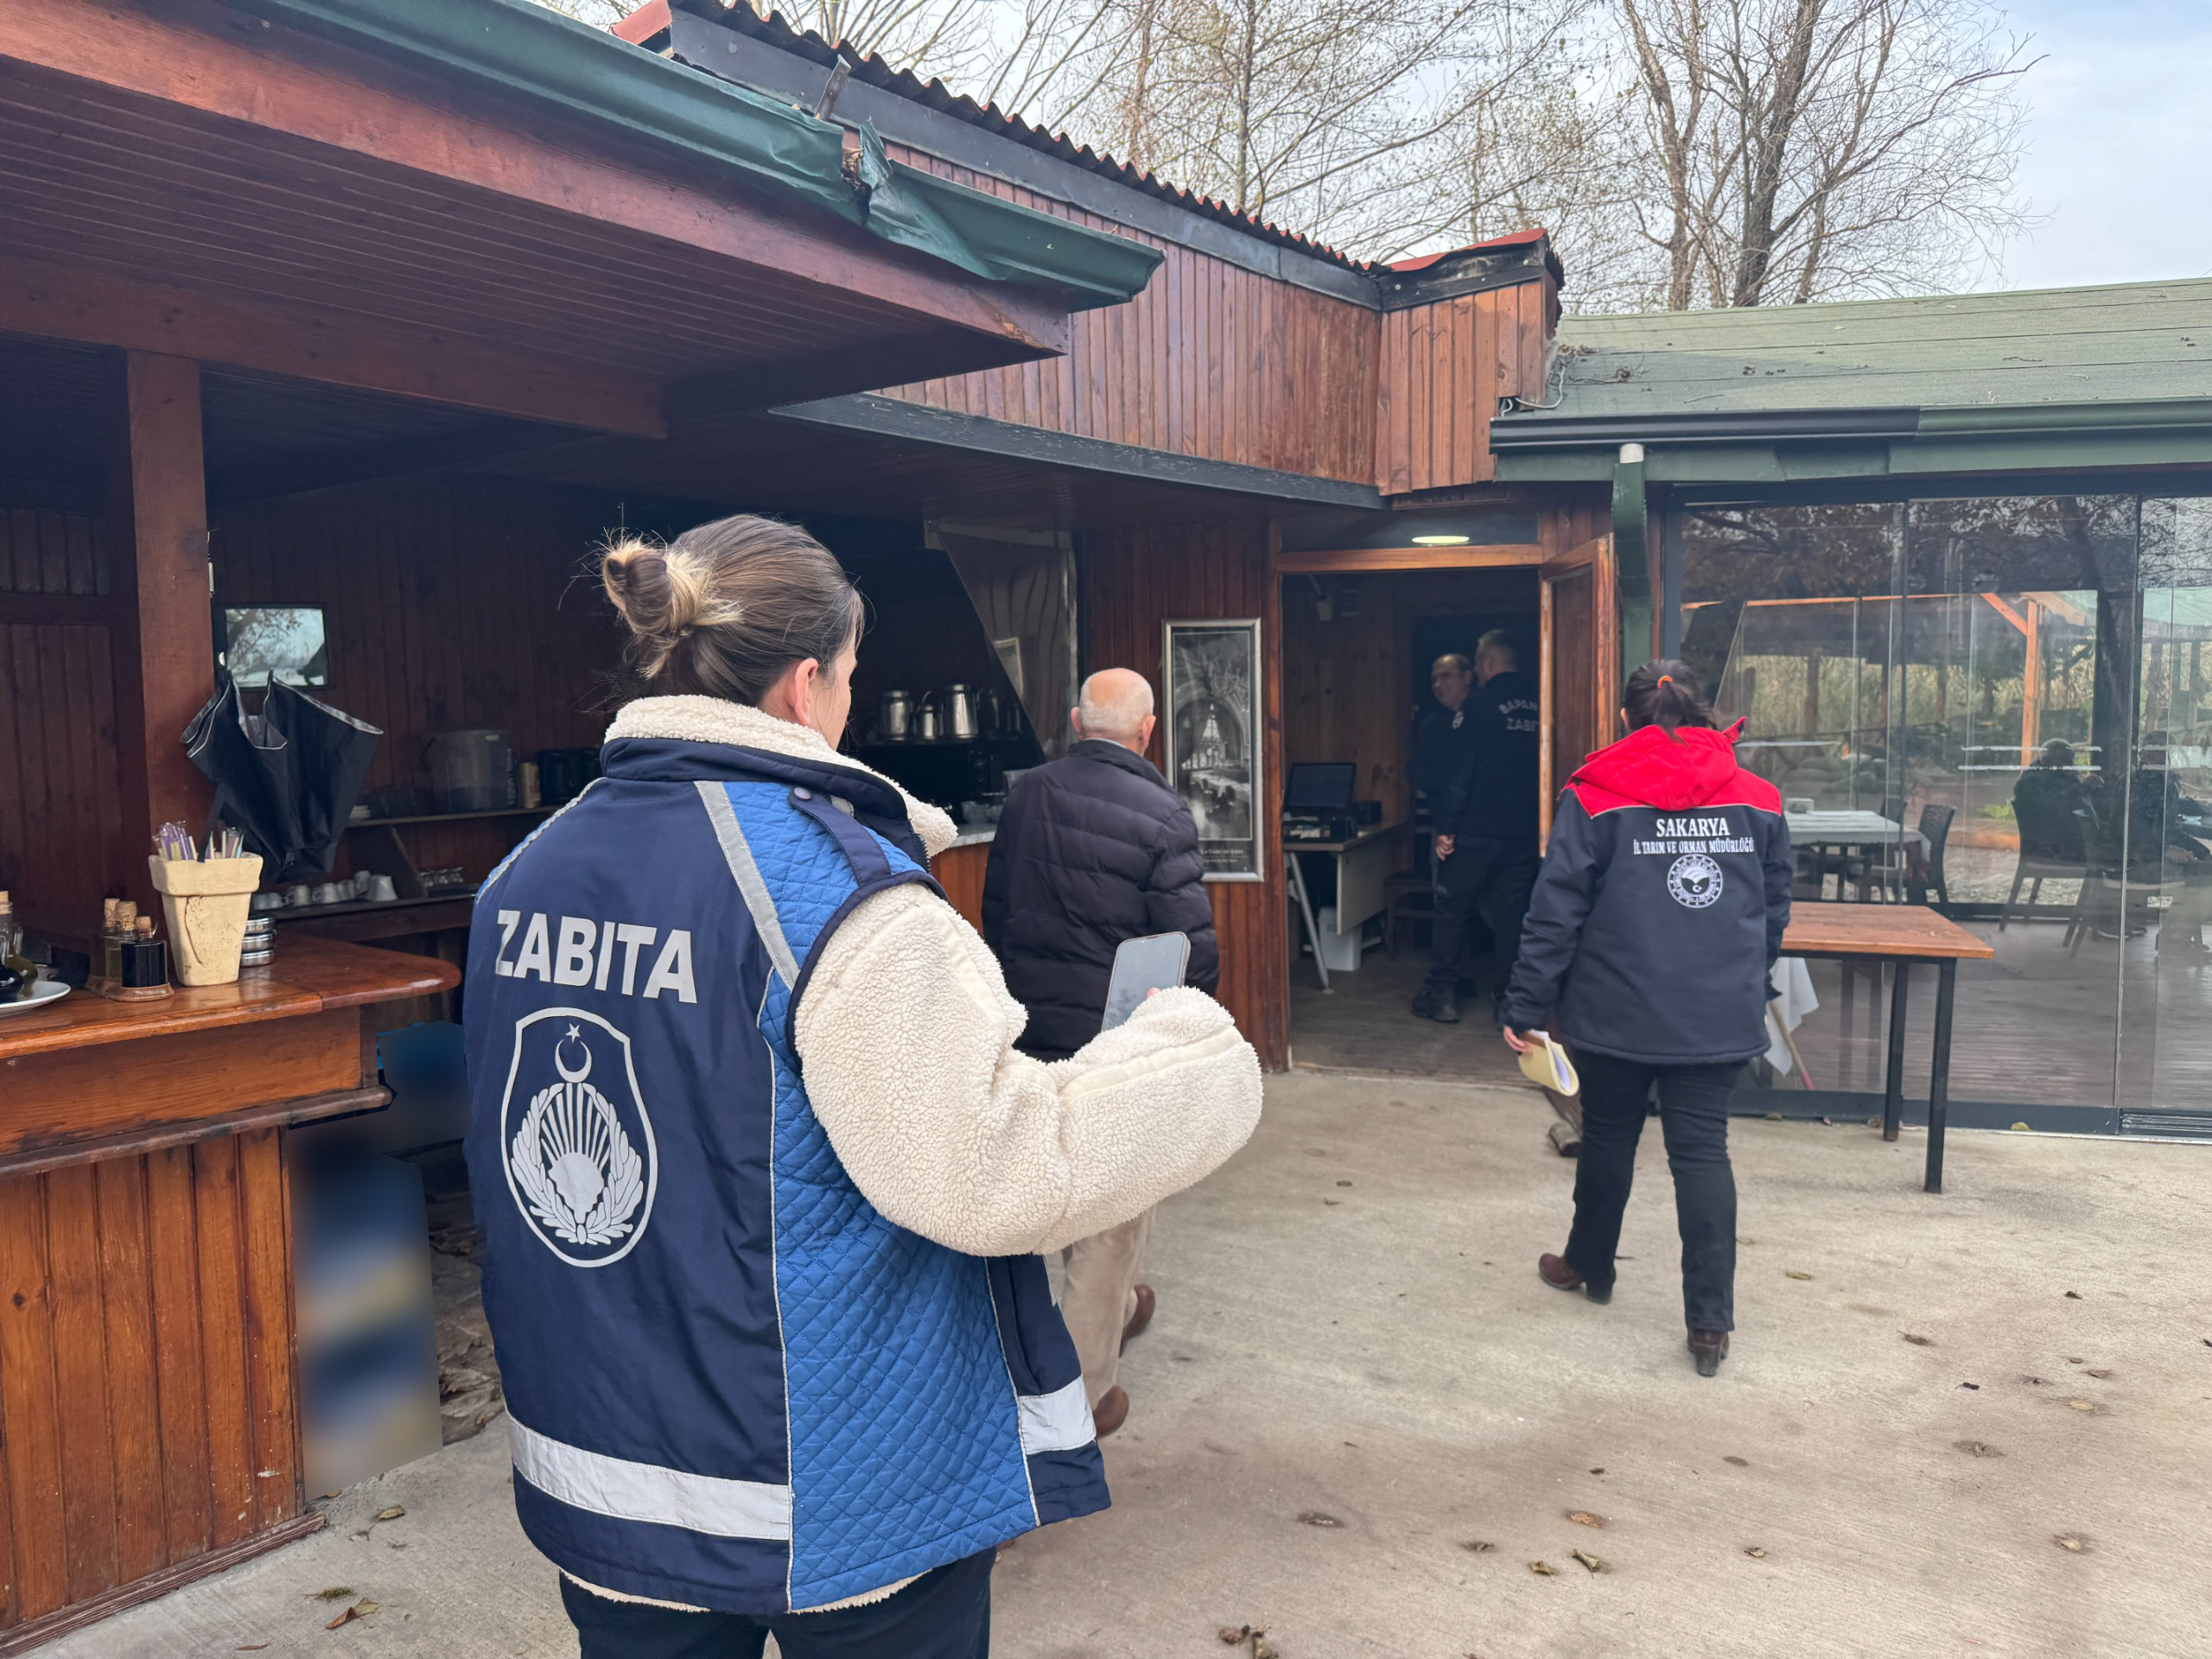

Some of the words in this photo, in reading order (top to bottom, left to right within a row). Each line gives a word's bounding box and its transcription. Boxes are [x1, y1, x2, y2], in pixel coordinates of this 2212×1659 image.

[1499, 699, 1538, 714] SAPAN
[1506, 717, 1540, 732] ZABI
[1656, 817, 1731, 837] SAKARYA
[1642, 841, 1666, 854] TARIM
[1667, 841, 1676, 854] VE
[1679, 841, 1707, 854] ORMAN
[495, 910, 697, 1003] ZABITA
